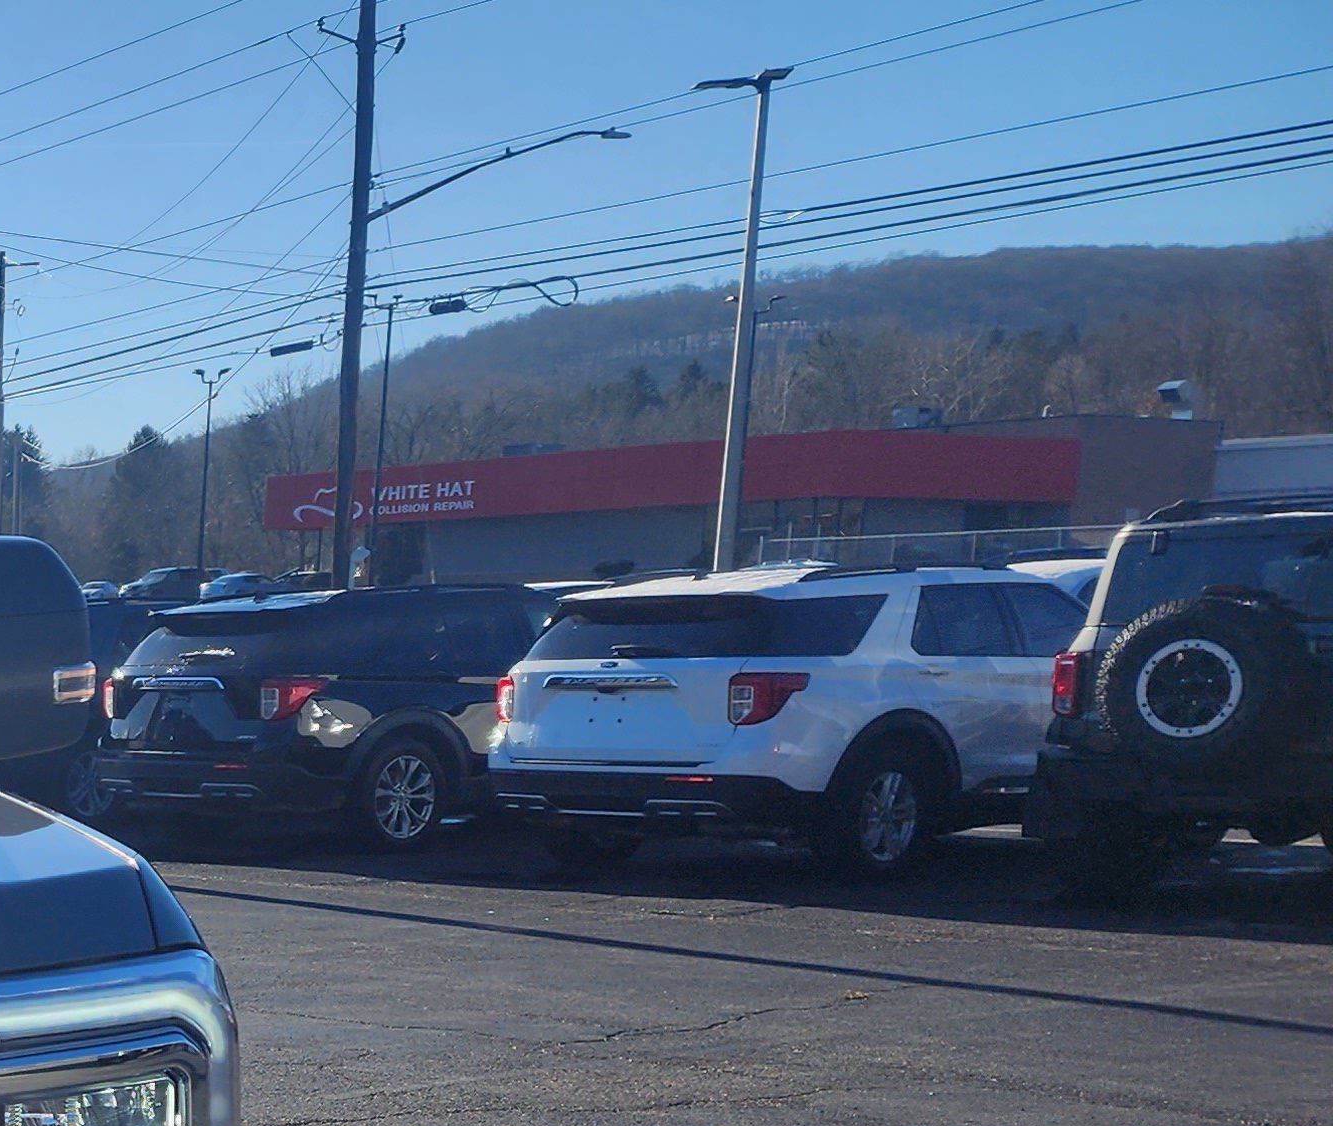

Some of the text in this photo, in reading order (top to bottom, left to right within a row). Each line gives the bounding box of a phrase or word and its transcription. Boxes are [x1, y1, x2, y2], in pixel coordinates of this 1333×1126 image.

[371, 481, 475, 501] WHITE HAT
[434, 500, 474, 511] REPAIR
